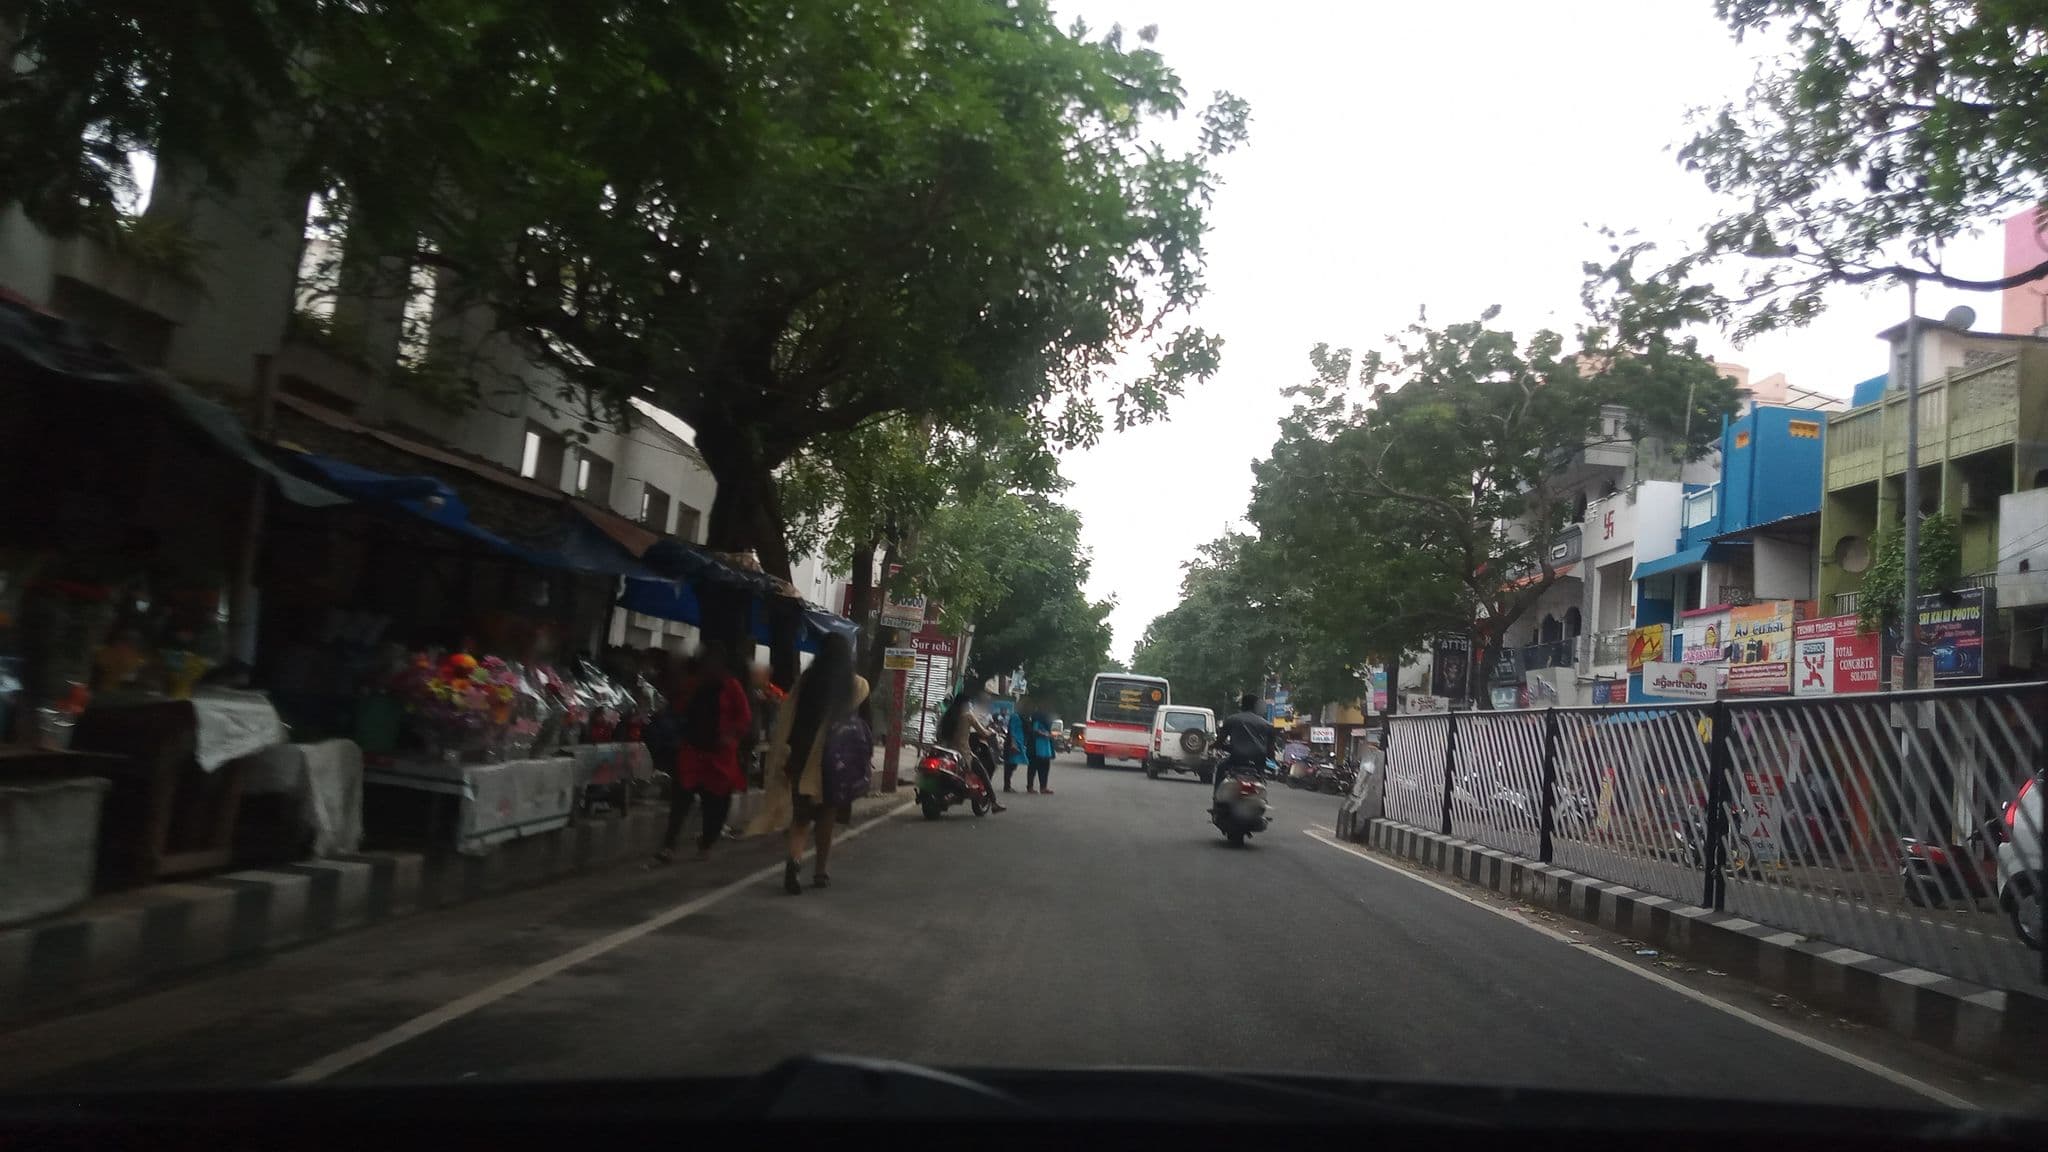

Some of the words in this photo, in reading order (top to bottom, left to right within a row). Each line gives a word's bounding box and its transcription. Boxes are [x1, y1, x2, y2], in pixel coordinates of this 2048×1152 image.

[1952, 606, 1980, 621] PHOTOS
[1835, 646, 1853, 657] TOTAL
[1840, 657, 1874, 670] CONCRETE
[1652, 676, 1708, 689] Jigarthanda
[1850, 671, 1877, 681] SOLUTION
